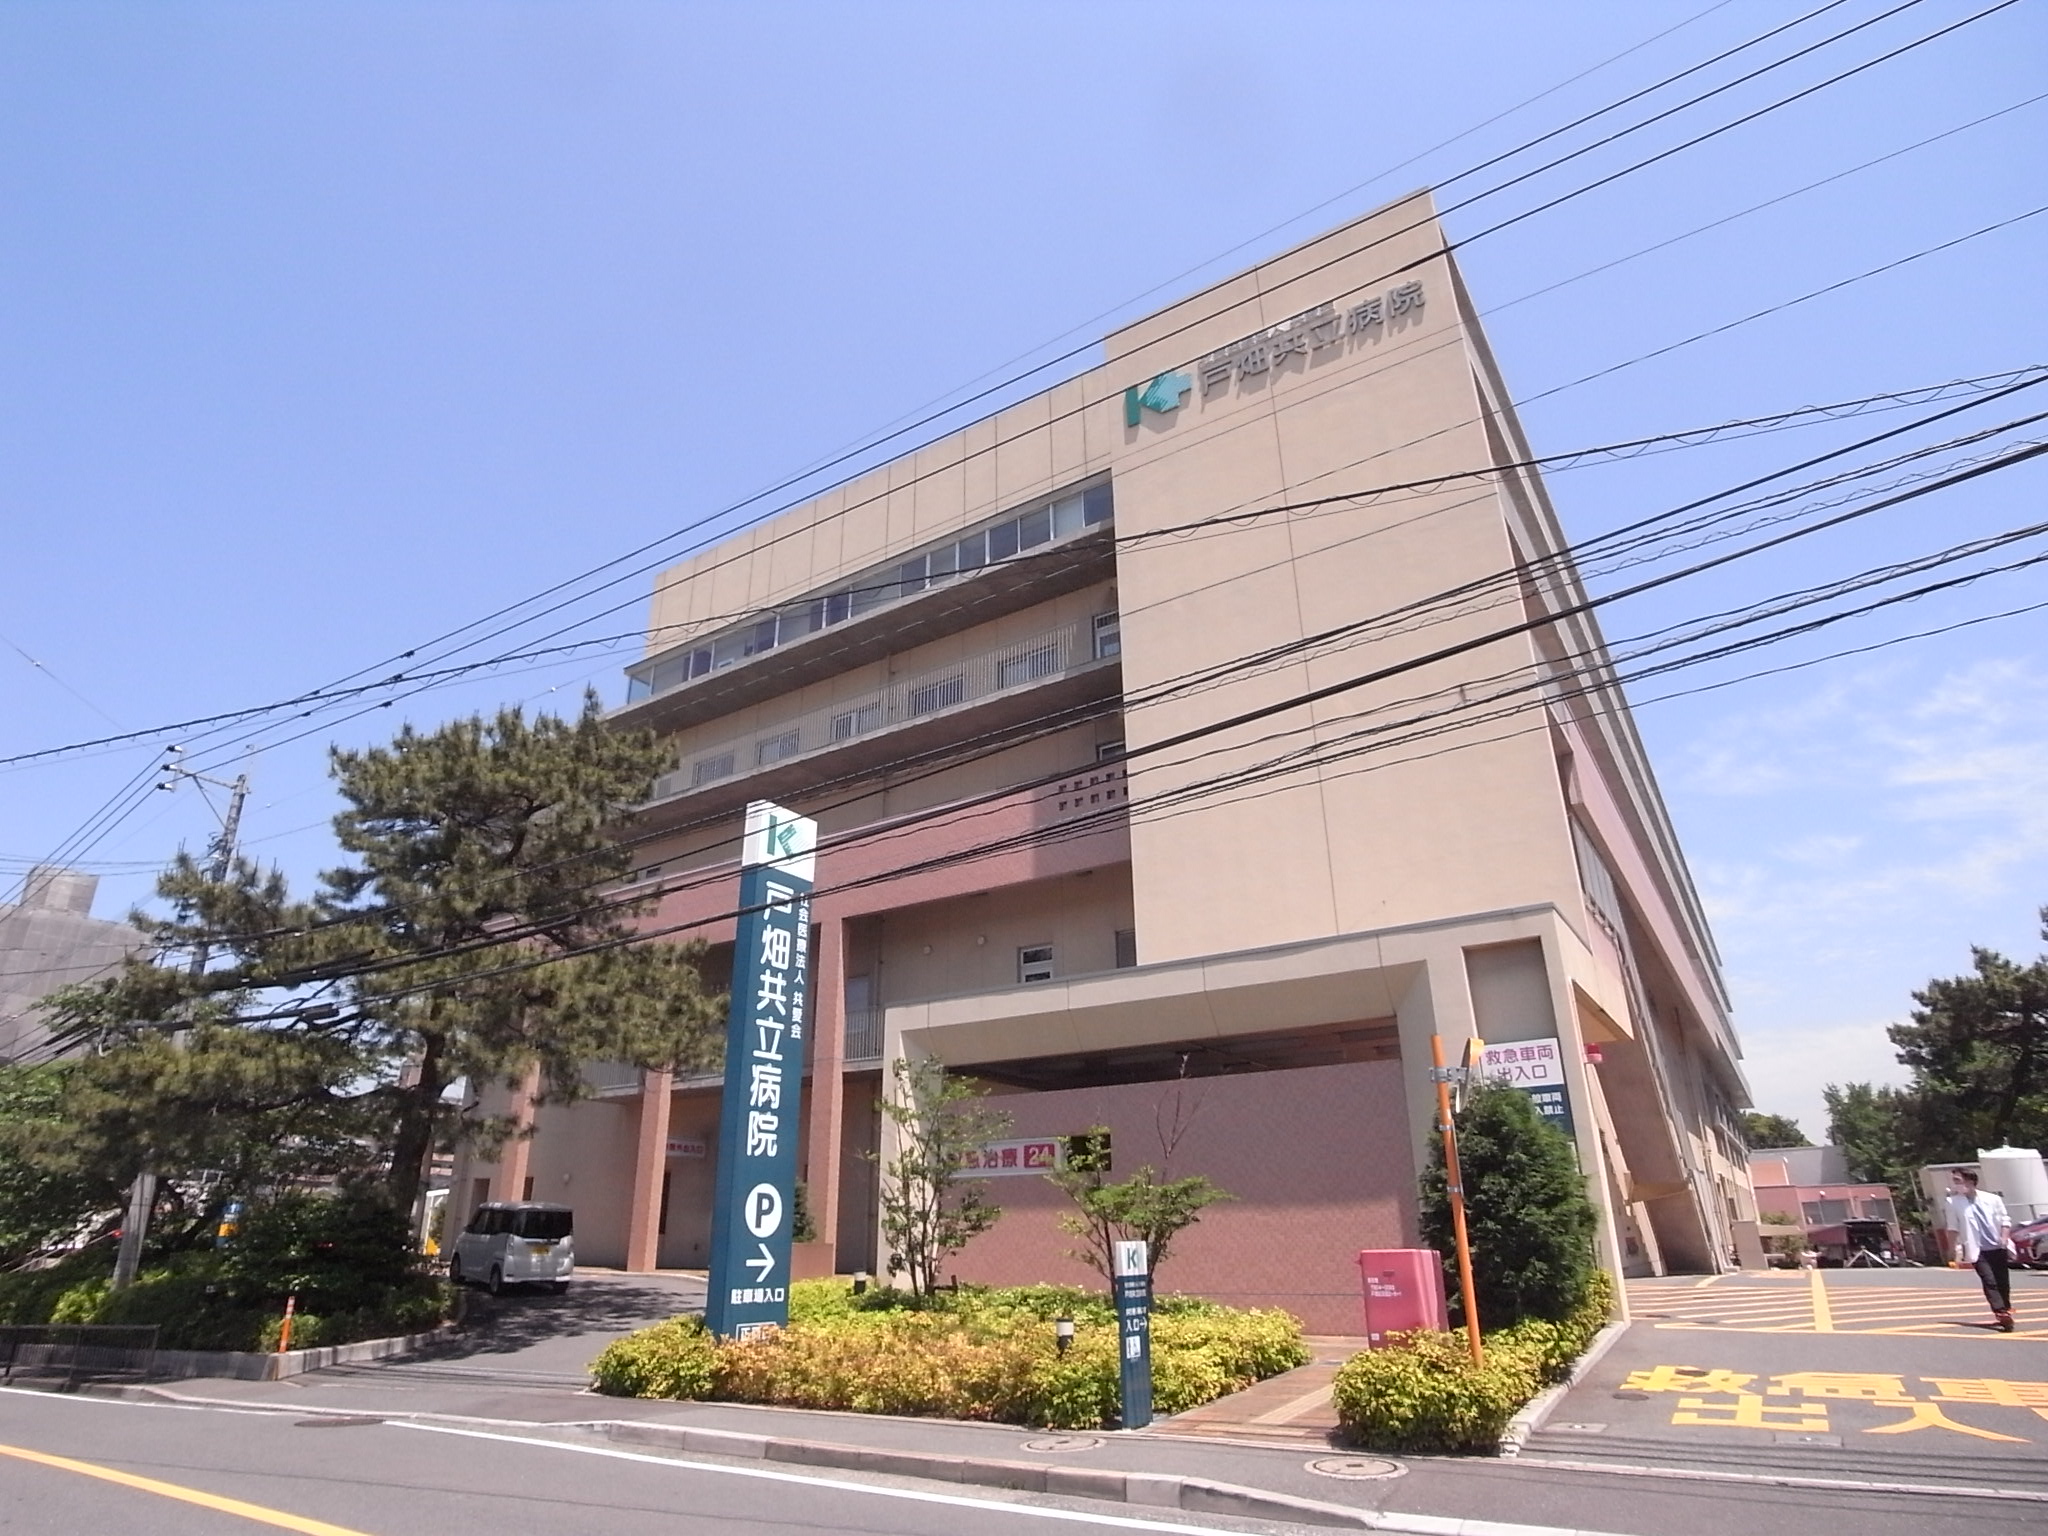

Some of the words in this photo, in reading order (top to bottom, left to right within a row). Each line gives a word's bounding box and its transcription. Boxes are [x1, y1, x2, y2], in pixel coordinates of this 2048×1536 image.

[747, 881, 795, 1157] 戸畑共立病院
[1486, 1045, 1554, 1066] 救急車両
[1497, 1064, 1548, 1082] 出入口
[1530, 1091, 1562, 1104] 般車両
[755, 1192, 775, 1229] P
[730, 1287, 785, 1305] 駐車場入口
[1671, 1394, 2048, 1443] 出入
